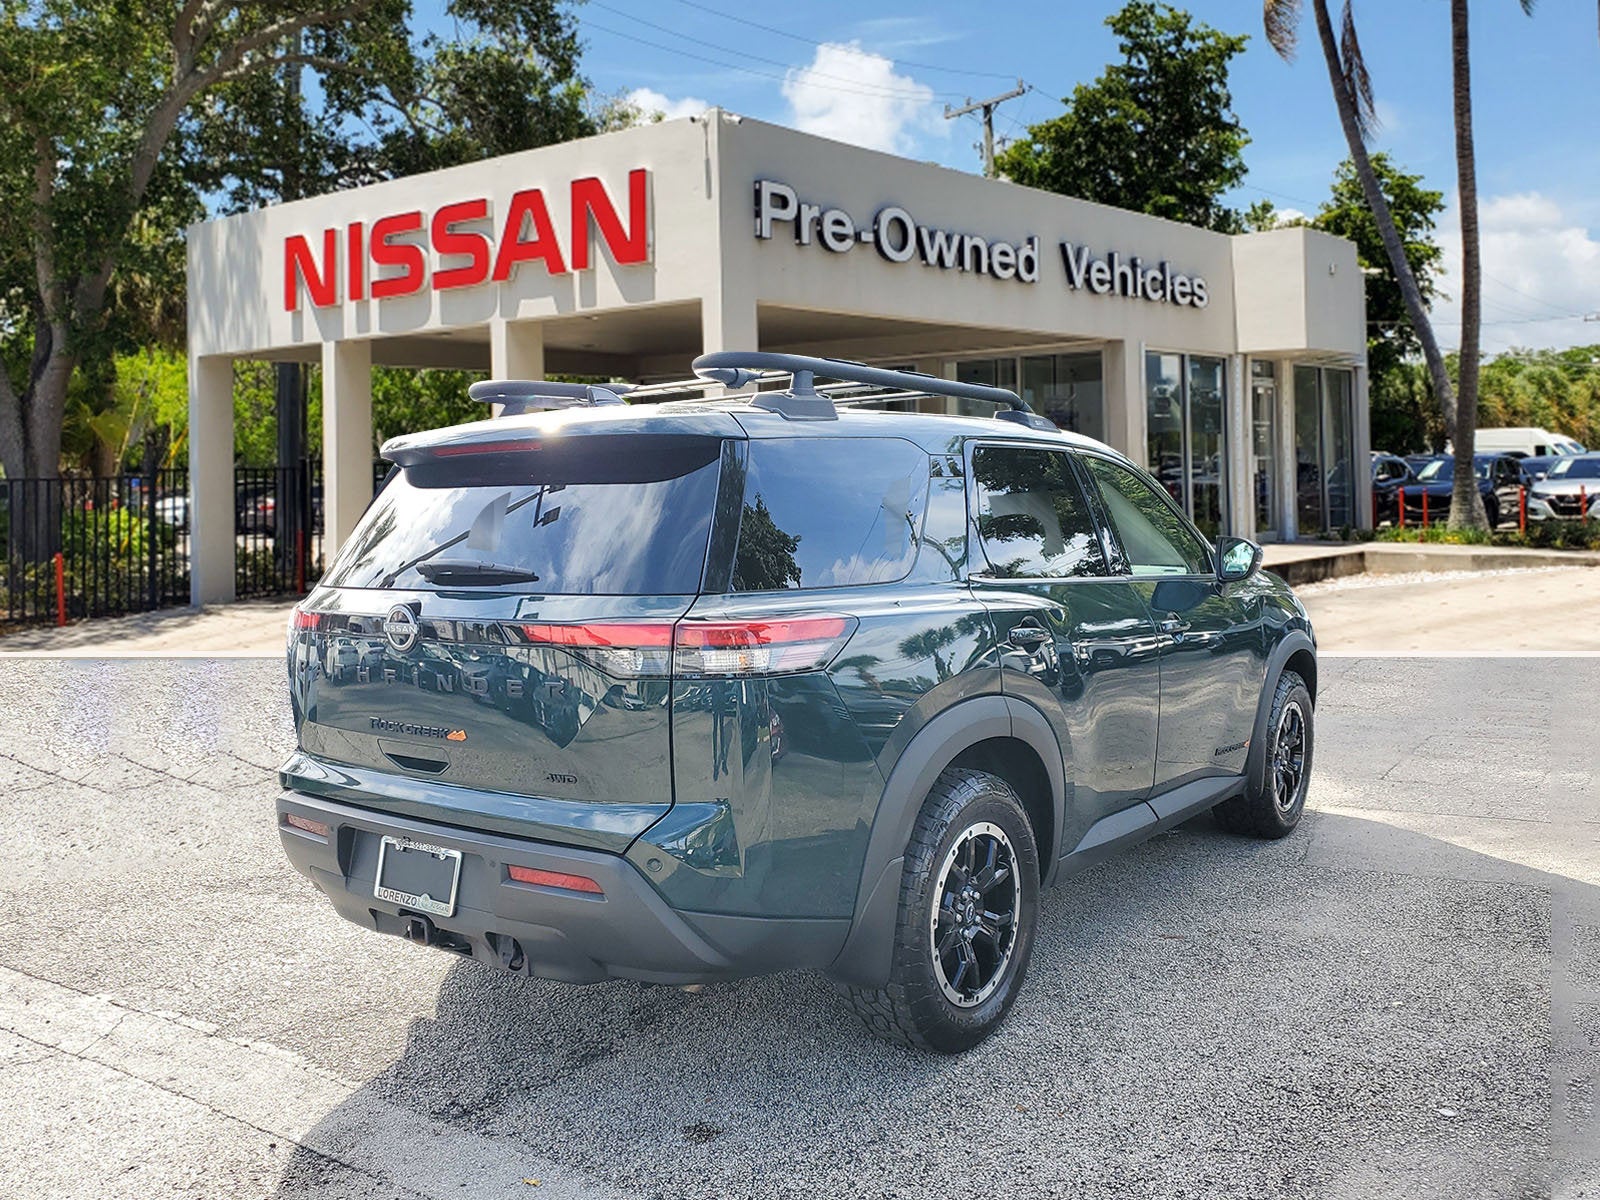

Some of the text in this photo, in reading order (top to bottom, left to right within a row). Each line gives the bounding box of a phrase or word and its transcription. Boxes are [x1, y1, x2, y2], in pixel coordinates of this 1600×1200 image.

[284, 168, 648, 312] NISSAN
[754, 179, 1209, 309] Pre-Owned Vehicles
[378, 887, 417, 906] LORENZO
